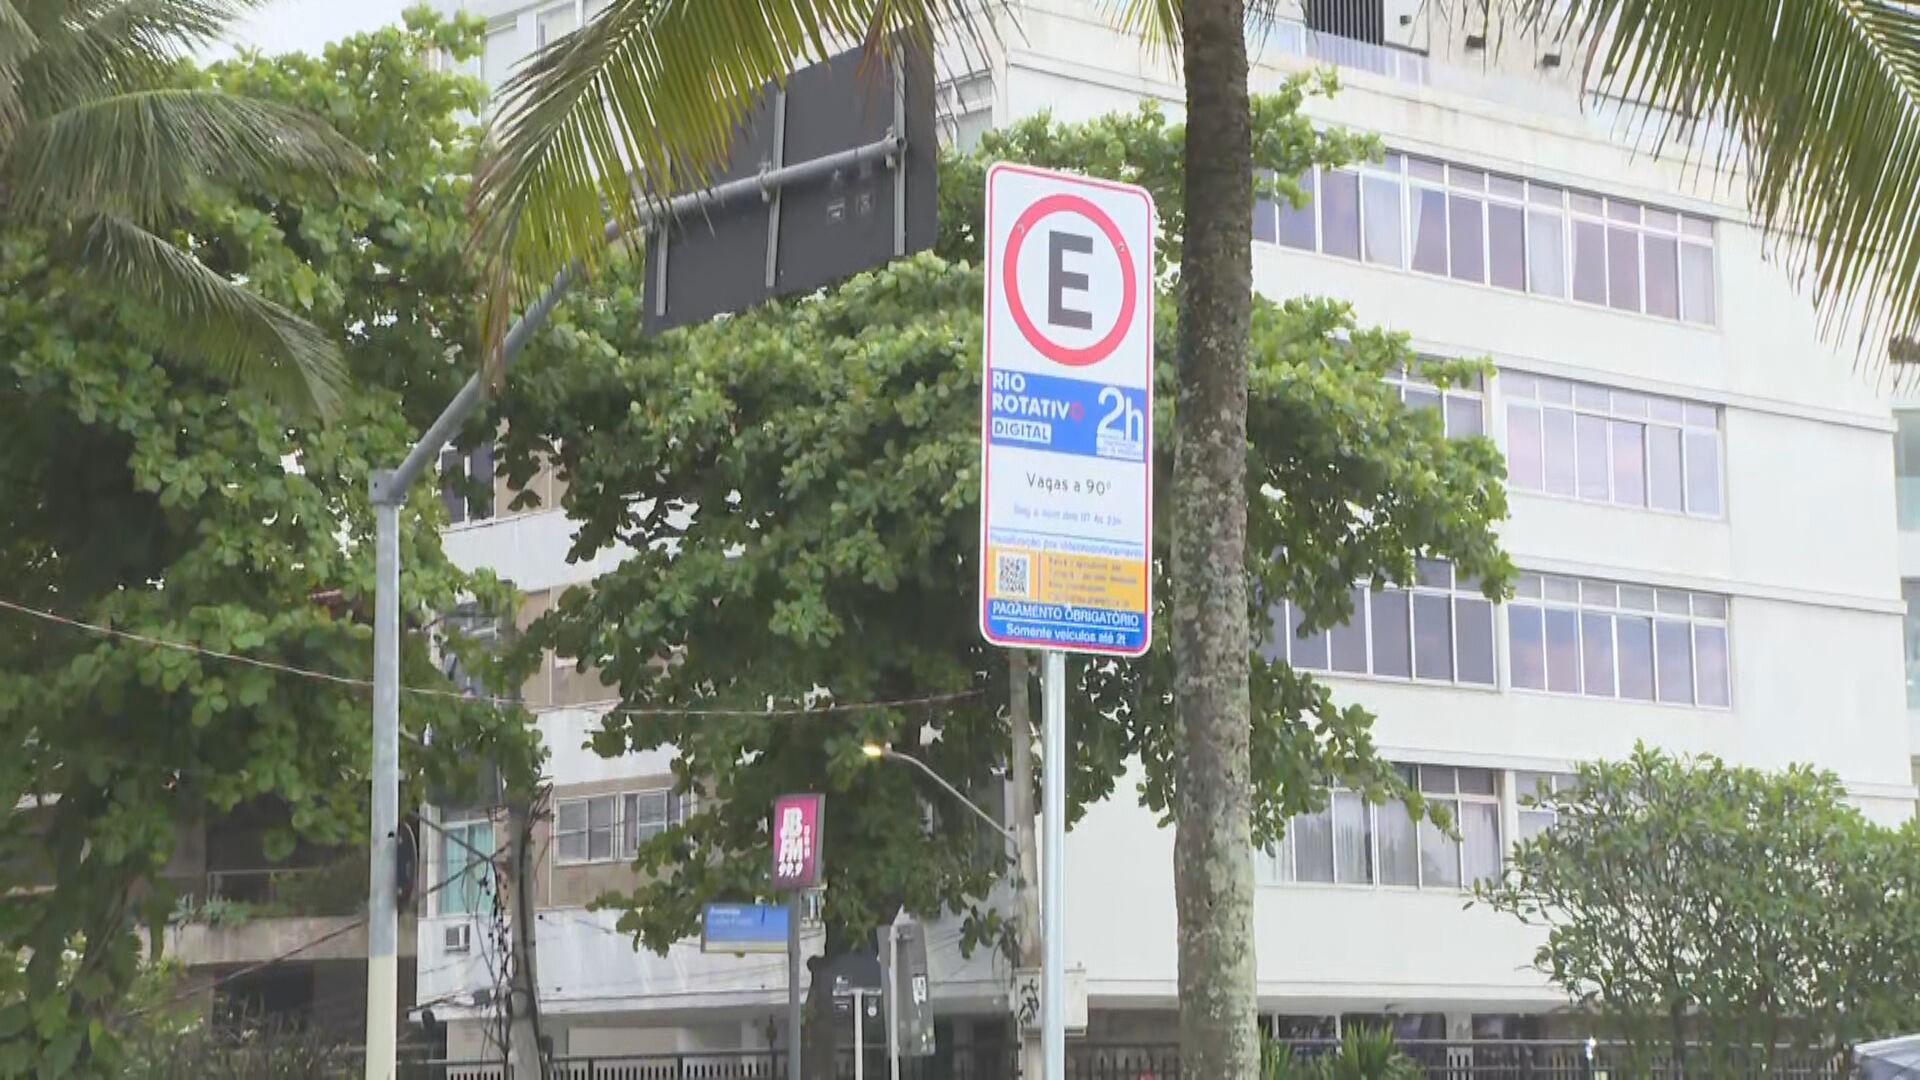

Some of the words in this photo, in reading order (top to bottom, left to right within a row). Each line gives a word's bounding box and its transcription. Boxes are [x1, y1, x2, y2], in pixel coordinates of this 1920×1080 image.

[1048, 230, 1093, 330] E
[992, 371, 1026, 393] RIO
[992, 393, 1084, 423] ROTATIVO
[1097, 386, 1144, 447] 2h
[994, 420, 1049, 441] DIGITAL
[1026, 472, 1068, 493] Vagas
[1073, 481, 1082, 493] a
[992, 601, 1062, 620] PAGAMENTO
[1065, 605, 1139, 627] OBRIGATÓRIO
[1006, 623, 1051, 638] Somente
[1055, 628, 1097, 643] veículos
[1099, 631, 1114, 644] até
[1116, 634, 1127, 647] 2t
[780, 807, 803, 837] JB
[779, 836, 803, 862] FM
